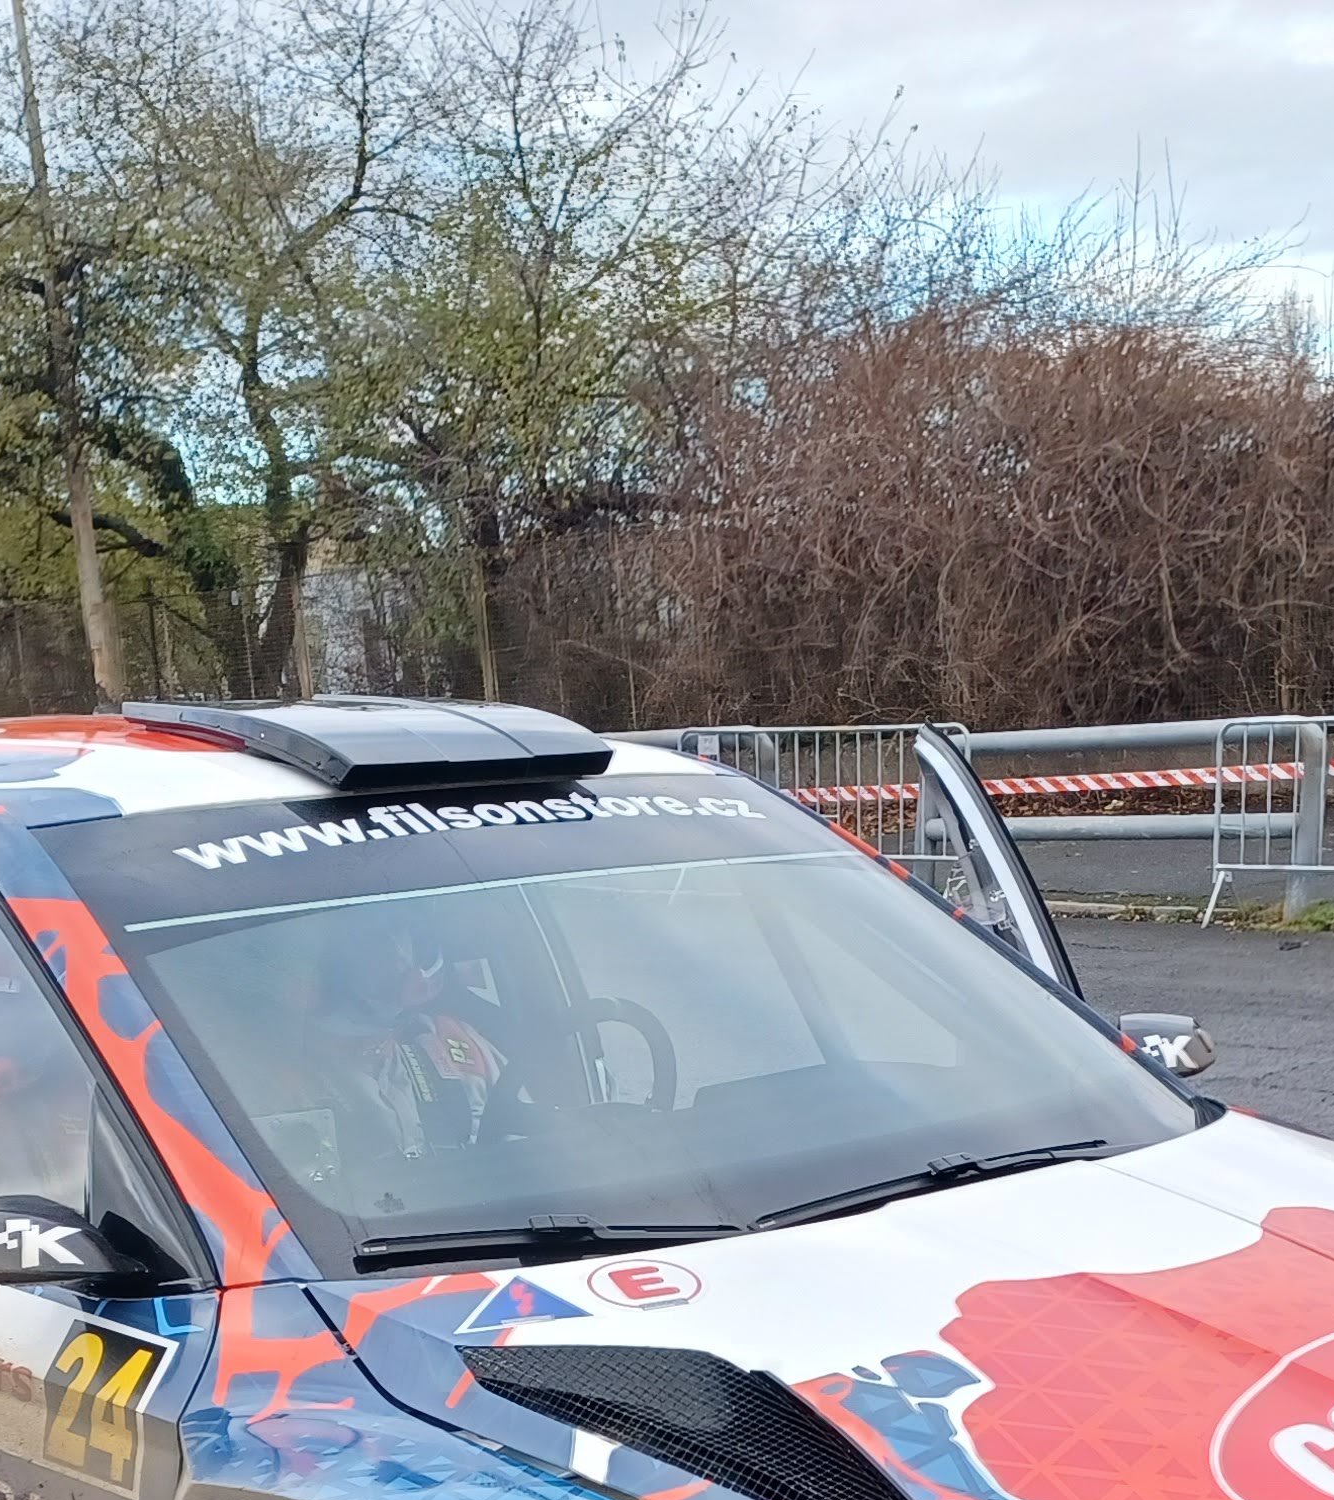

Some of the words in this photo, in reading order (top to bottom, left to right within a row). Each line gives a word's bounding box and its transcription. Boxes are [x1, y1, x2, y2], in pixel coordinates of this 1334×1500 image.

[172, 791, 767, 870] www.filsonstore.cz
[608, 1265, 681, 1300] E
[48, 1331, 155, 1483] 24
